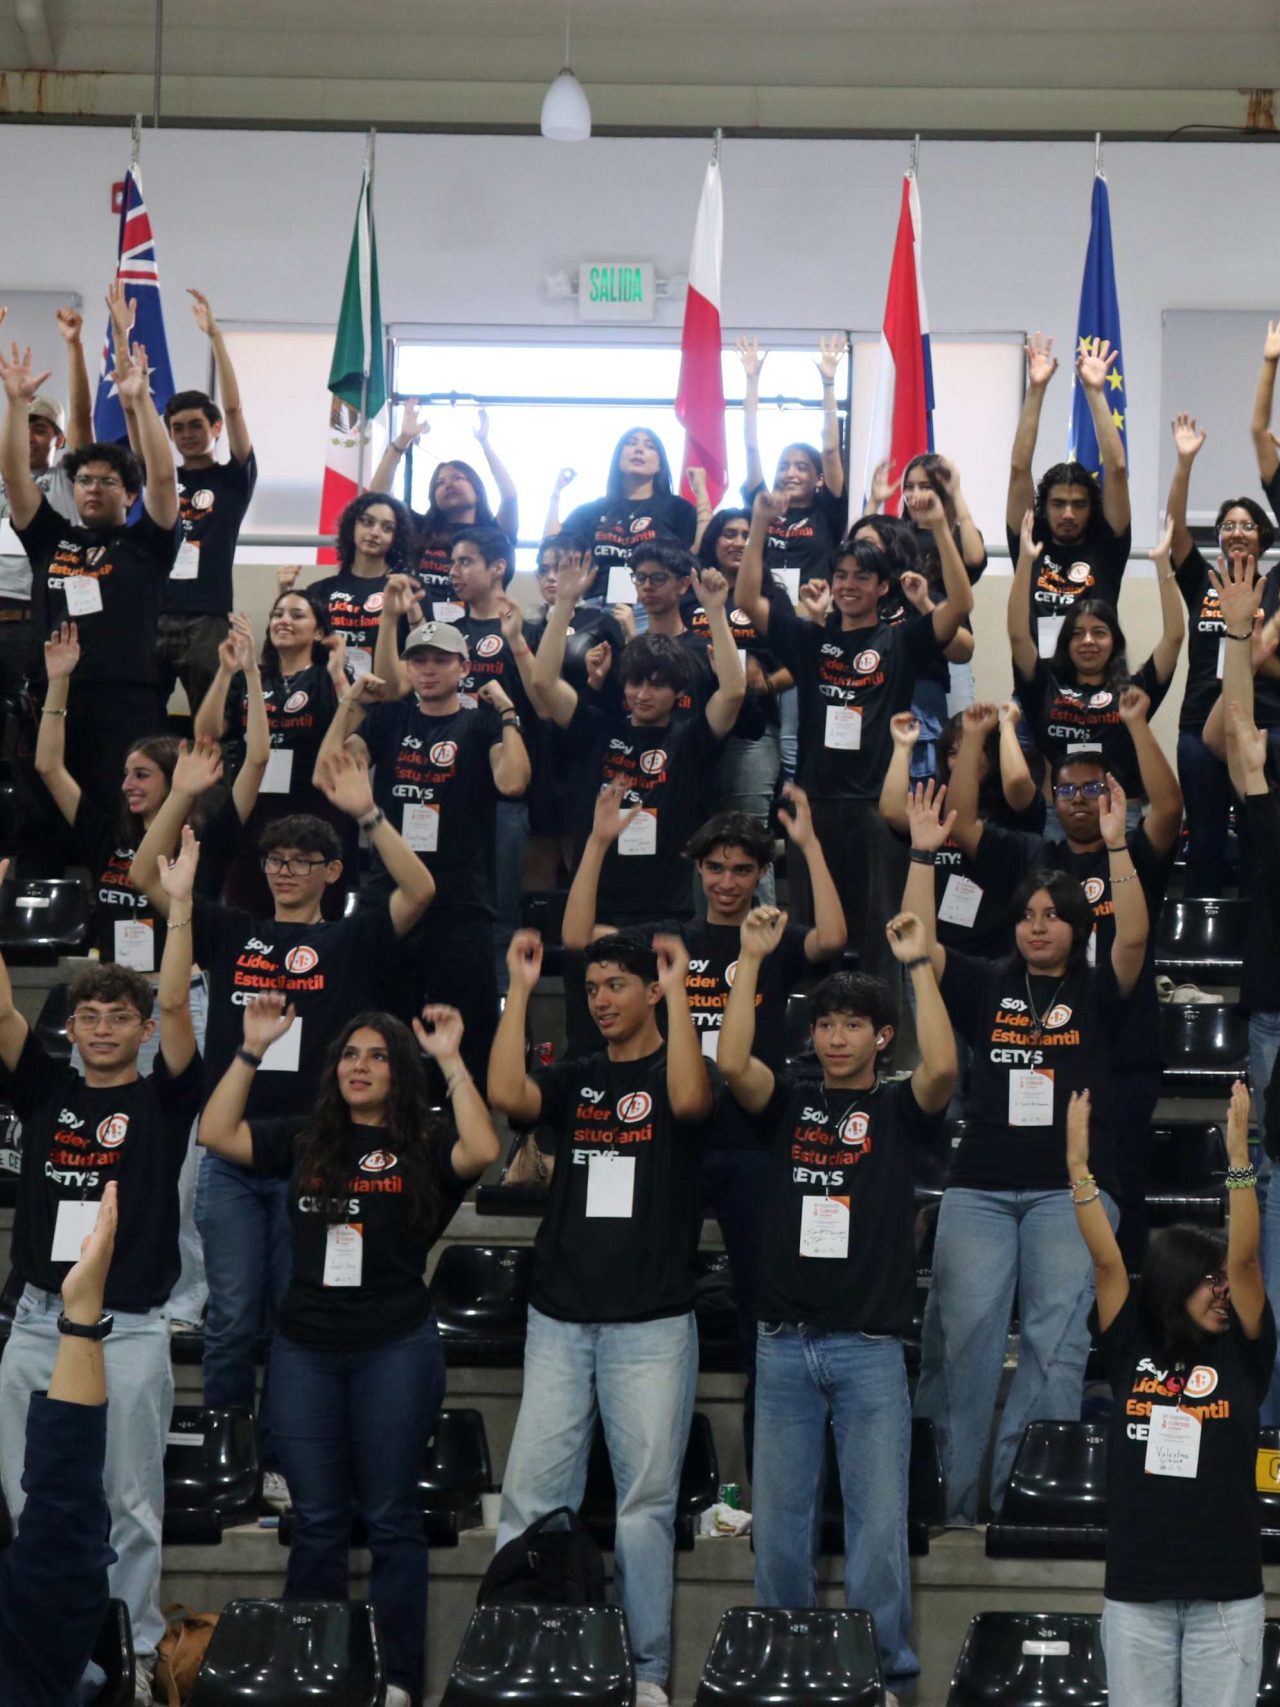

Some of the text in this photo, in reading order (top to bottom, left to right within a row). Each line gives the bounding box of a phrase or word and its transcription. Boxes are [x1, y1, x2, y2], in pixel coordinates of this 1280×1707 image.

[590, 267, 643, 302] SALIDA
[53, 550, 80, 563] Líde
[1034, 591, 1075, 604] CETYS
[1198, 620, 1227, 633] CETY
[820, 643, 845, 658] Soy
[609, 739, 634, 755] Soy
[391, 784, 434, 800] CETYS
[244, 937, 275, 956] Soy
[235, 954, 280, 973] Líder
[688, 959, 711, 974] oy
[233, 971, 325, 991] Estudiantil
[685, 974, 720, 988] íder
[999, 997, 1029, 1013] Soy
[690, 1012, 725, 1027] ETYS
[989, 1047, 1045, 1065] CETYS
[580, 1087, 606, 1104] oy
[58, 1108, 86, 1130] Soy
[576, 1104, 613, 1121] íder
[800, 1106, 830, 1126] Soy
[53, 1129, 91, 1149] íder
[574, 1122, 653, 1144] studianti
[1135, 1356, 1169, 1383] Soy
[1132, 1376, 1175, 1398] Líde
[1126, 1398, 1230, 1420] Estntil
